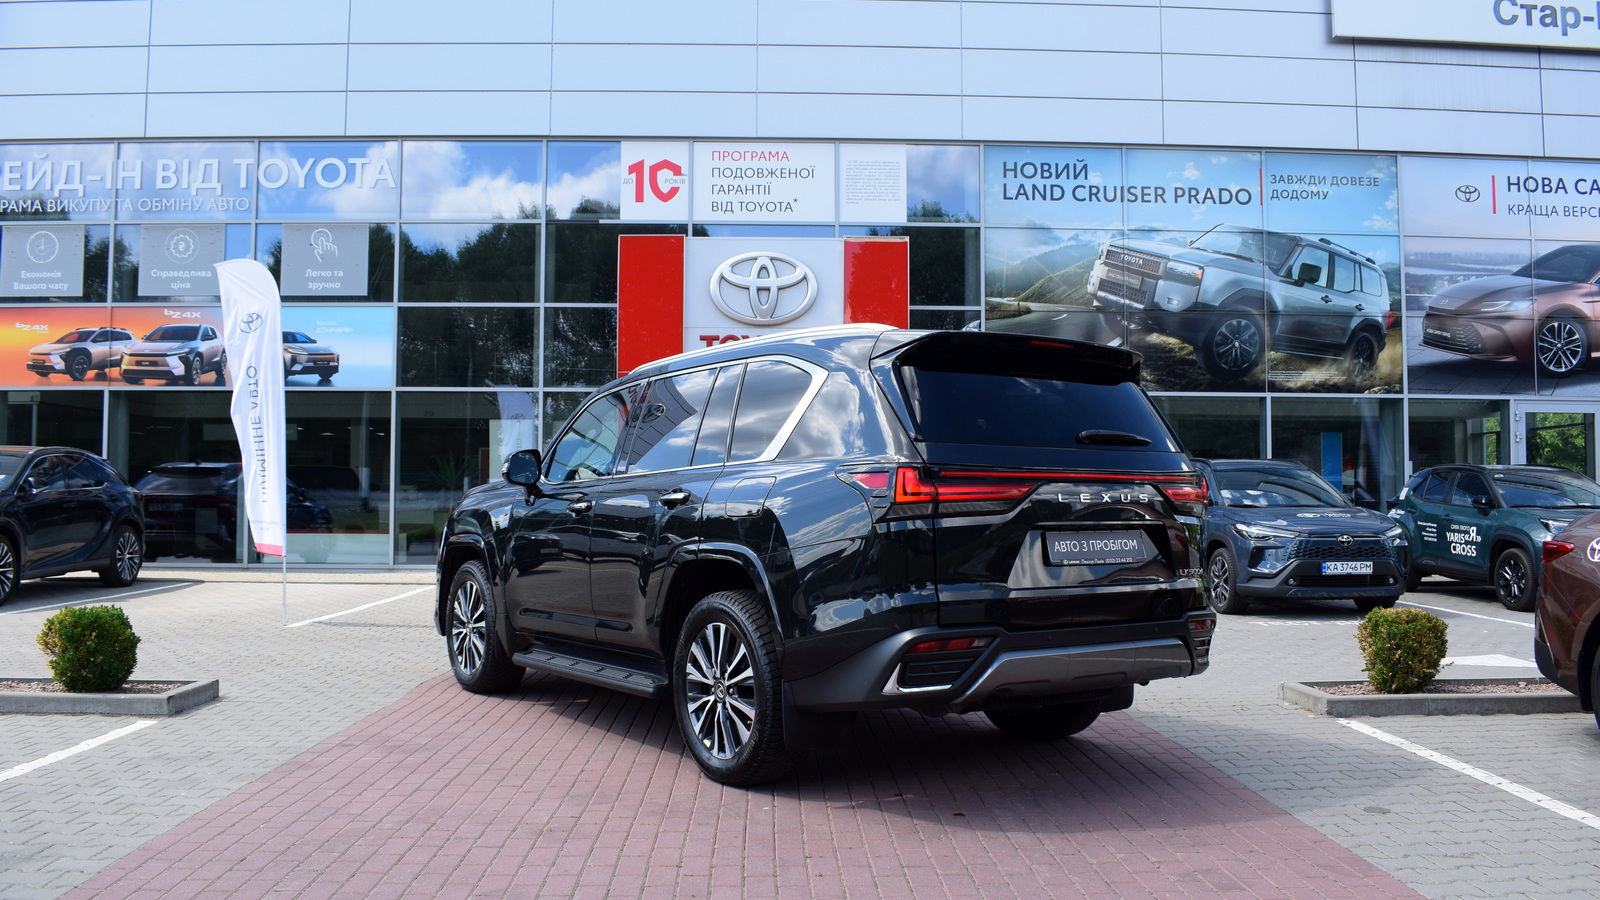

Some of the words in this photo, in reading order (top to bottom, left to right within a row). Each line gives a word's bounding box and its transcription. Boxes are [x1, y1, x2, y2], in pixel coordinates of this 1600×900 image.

[1493, 0, 1600, 36] Стар-
[711, 150, 790, 162] ПРОГРАМА
[156, 158, 222, 196] ВІД
[233, 157, 397, 190] TOYOTA
[711, 165, 816, 180] ПОДОВЖЕНОЇ
[1002, 158, 1089, 181] НОВИЙ
[1270, 174, 1327, 187] ЗАВЖДИ
[1330, 176, 1380, 188] ДОВЕЗЕ
[1506, 175, 1569, 195] НОВА
[711, 181, 772, 196] ГАРАНТІЇ
[1002, 183, 1065, 202] LAND
[1071, 184, 1167, 204] CRUISER
[1173, 186, 1253, 206] PRADO
[1270, 189, 1330, 201] ДОДОМУ
[47, 198, 111, 213] ВИКУПУ
[116, 197, 134, 212] ТА
[137, 197, 202, 212] ОБМІНУ
[206, 197, 250, 211] АВТО
[711, 201, 735, 215] ВІД
[1507, 204, 1559, 218] КРАЩА
[1120, 254, 1143, 265] TOYOTA
[20, 269, 62, 279] Економія
[150, 269, 212, 279] Справедлива
[304, 268, 332, 277] Легко
[13, 281, 47, 290] Вашого
[48, 282, 69, 291] часу
[170, 280, 191, 290] ціна
[307, 281, 341, 291] зручно
[1057, 493, 1149, 503] LEXUS
[1446, 531, 1465, 544] YARIS
[1054, 541, 1080, 553] АВТО
[1089, 539, 1138, 551] ПРОБІГОМ
[1450, 542, 1477, 557] CROSS
[1326, 562, 1339, 572] KA
[1339, 562, 1359, 572] 3746
[1359, 562, 1372, 572] PM
